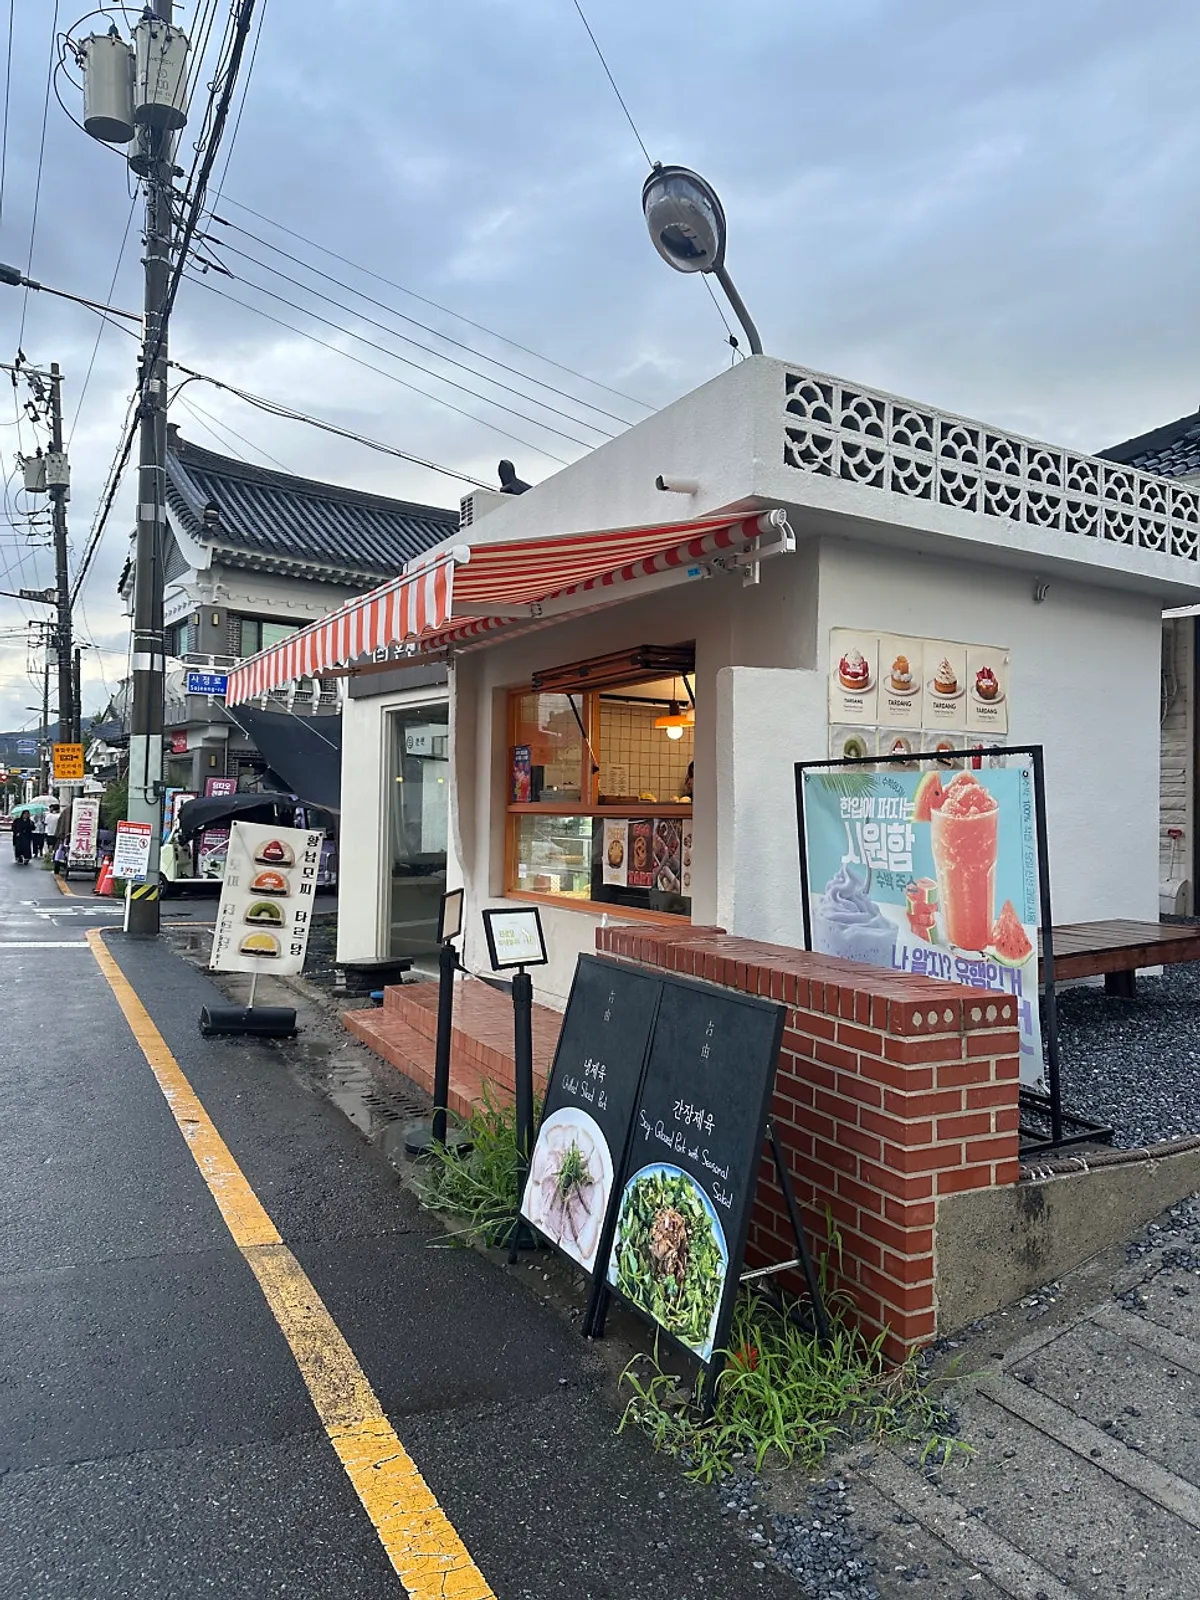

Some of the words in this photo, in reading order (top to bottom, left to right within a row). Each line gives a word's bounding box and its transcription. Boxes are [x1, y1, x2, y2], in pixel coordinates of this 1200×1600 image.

[190, 684, 224, 694] Sajeong-ro
[191, 675, 222, 686] 사정로
[839, 795, 875, 820] 한입에
[877, 796, 916, 821] 퍼지는
[841, 821, 917, 872] 시원함
[876, 871, 894, 891] 수박
[895, 872, 918, 894] 주스
[891, 944, 909, 970] 나
[584, 1057, 608, 1085] 냉제육
[580, 1080, 594, 1104] Sliced
[598, 1094, 608, 1111] Pork
[672, 1098, 716, 1137] 간장제육
[675, 1130, 687, 1154] Pork
[687, 1144, 699, 1163] with
[701, 1148, 729, 1181] Seasonal
[711, 1181, 733, 1210] Salad
